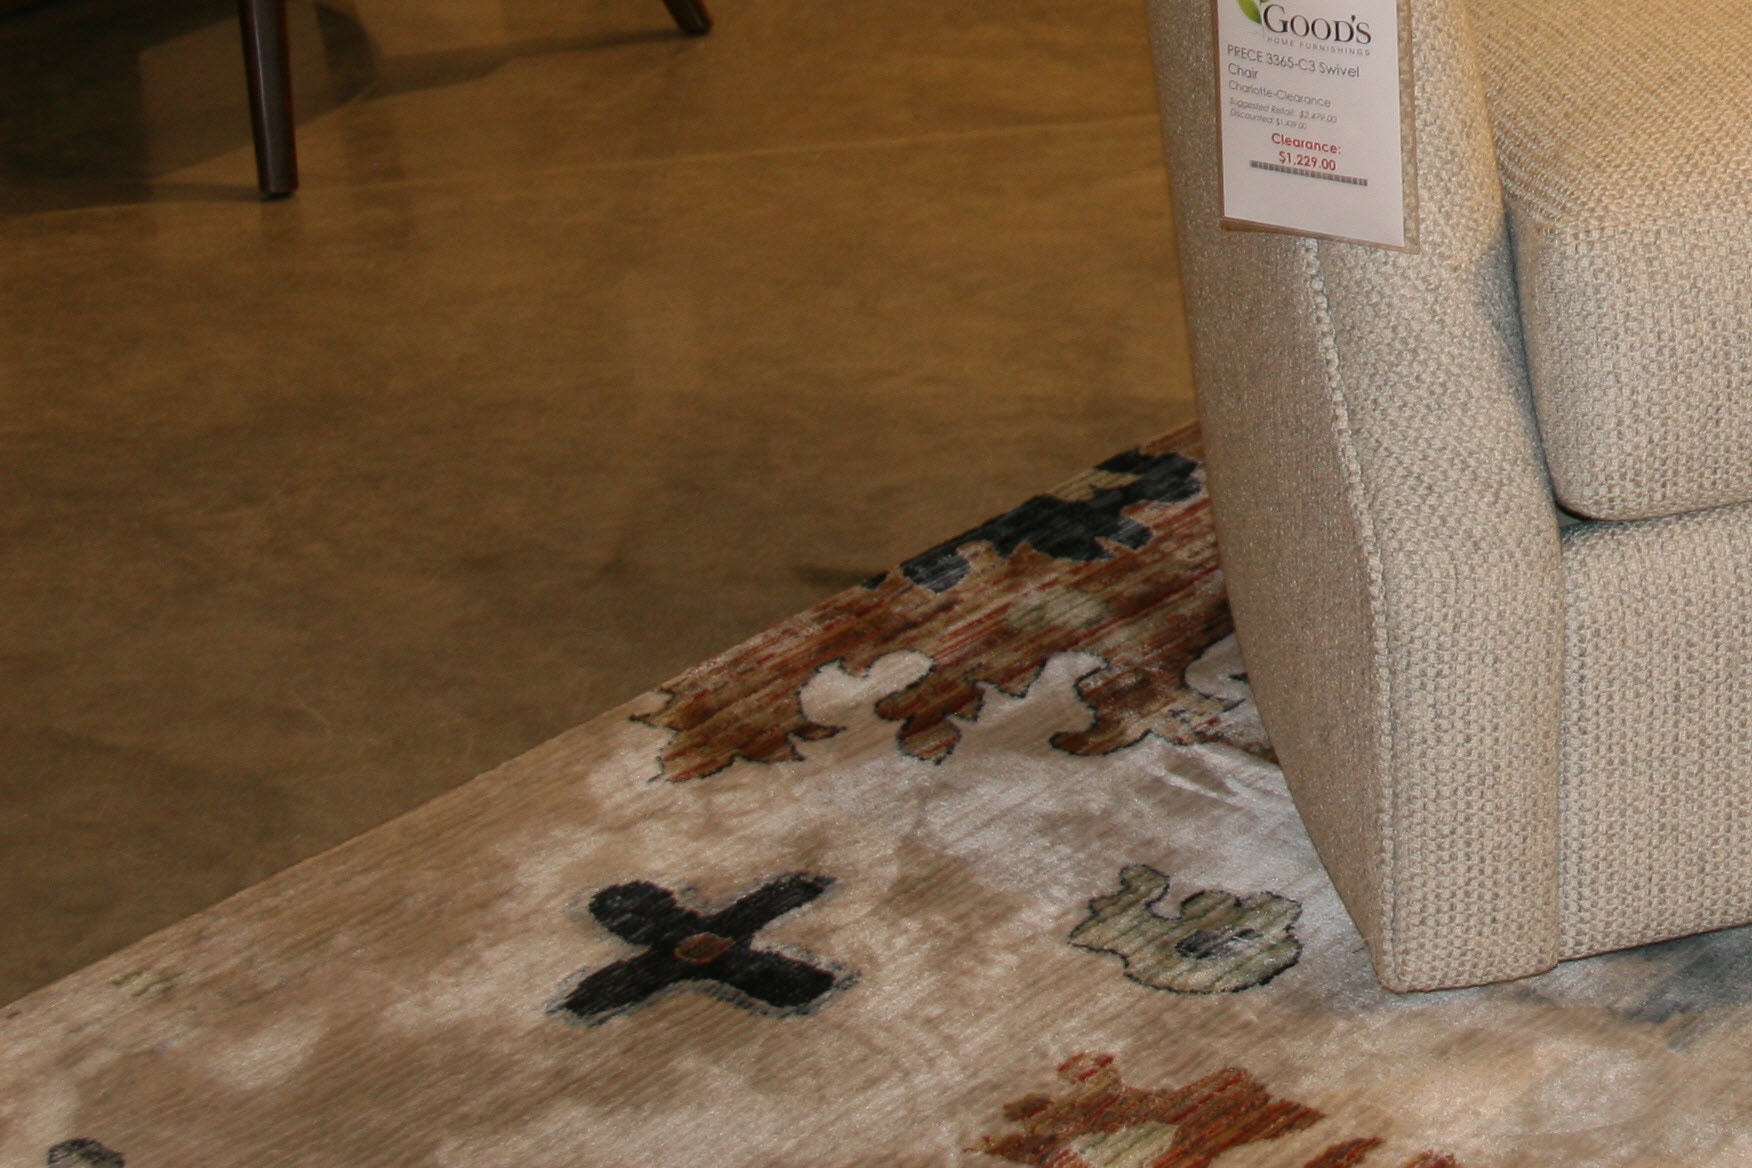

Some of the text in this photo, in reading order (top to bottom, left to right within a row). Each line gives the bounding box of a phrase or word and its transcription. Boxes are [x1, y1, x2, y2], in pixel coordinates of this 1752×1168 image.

[1263, 3, 1372, 45] GOOD'S
[1267, 35, 1371, 56] HOME FURNISHINGS
[1227, 44, 1361, 78] PRECE 3365-C3 Swivel
[1227, 62, 1258, 80] Chair
[1228, 79, 1332, 108] Charlotte-Clearance
[1271, 131, 1342, 155] Clearance:
[1279, 150, 1337, 172] $1,229.00
